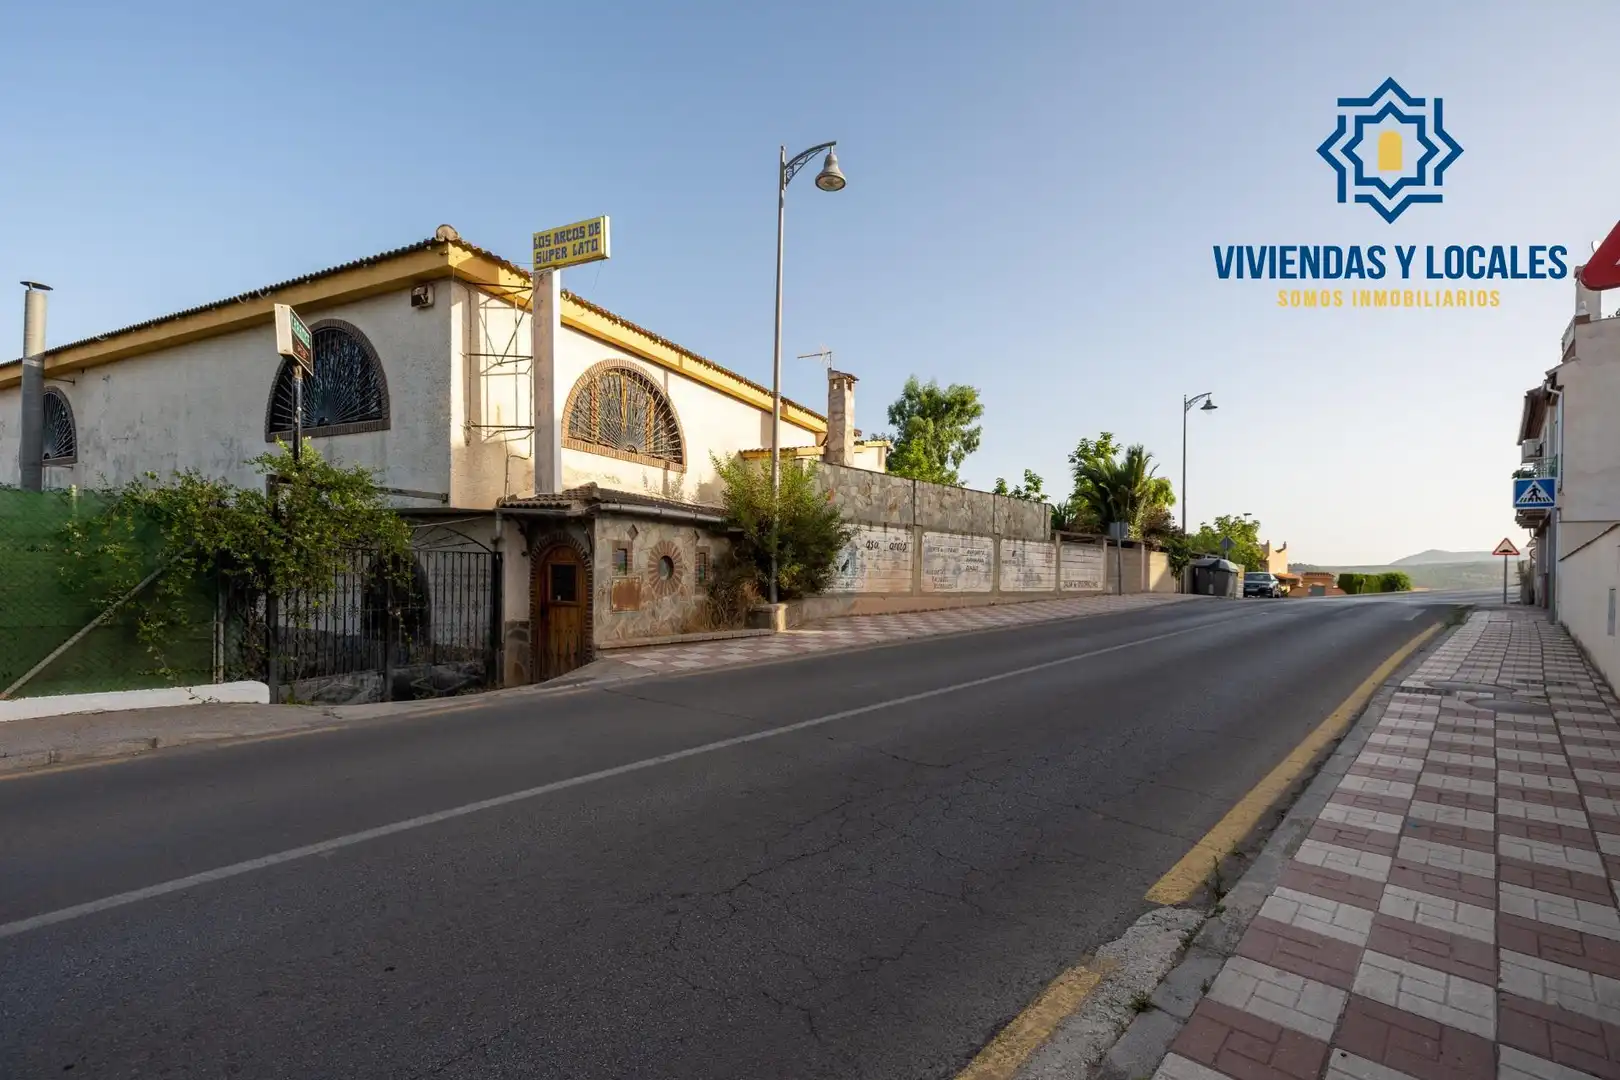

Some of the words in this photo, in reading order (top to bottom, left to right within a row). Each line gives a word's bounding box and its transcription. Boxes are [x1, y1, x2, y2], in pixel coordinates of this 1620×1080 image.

[533, 234, 551, 249] LOS
[554, 226, 585, 245] ARCOS
[588, 222, 600, 237] DE
[536, 246, 567, 264] SUPER
[573, 238, 598, 256] LATO
